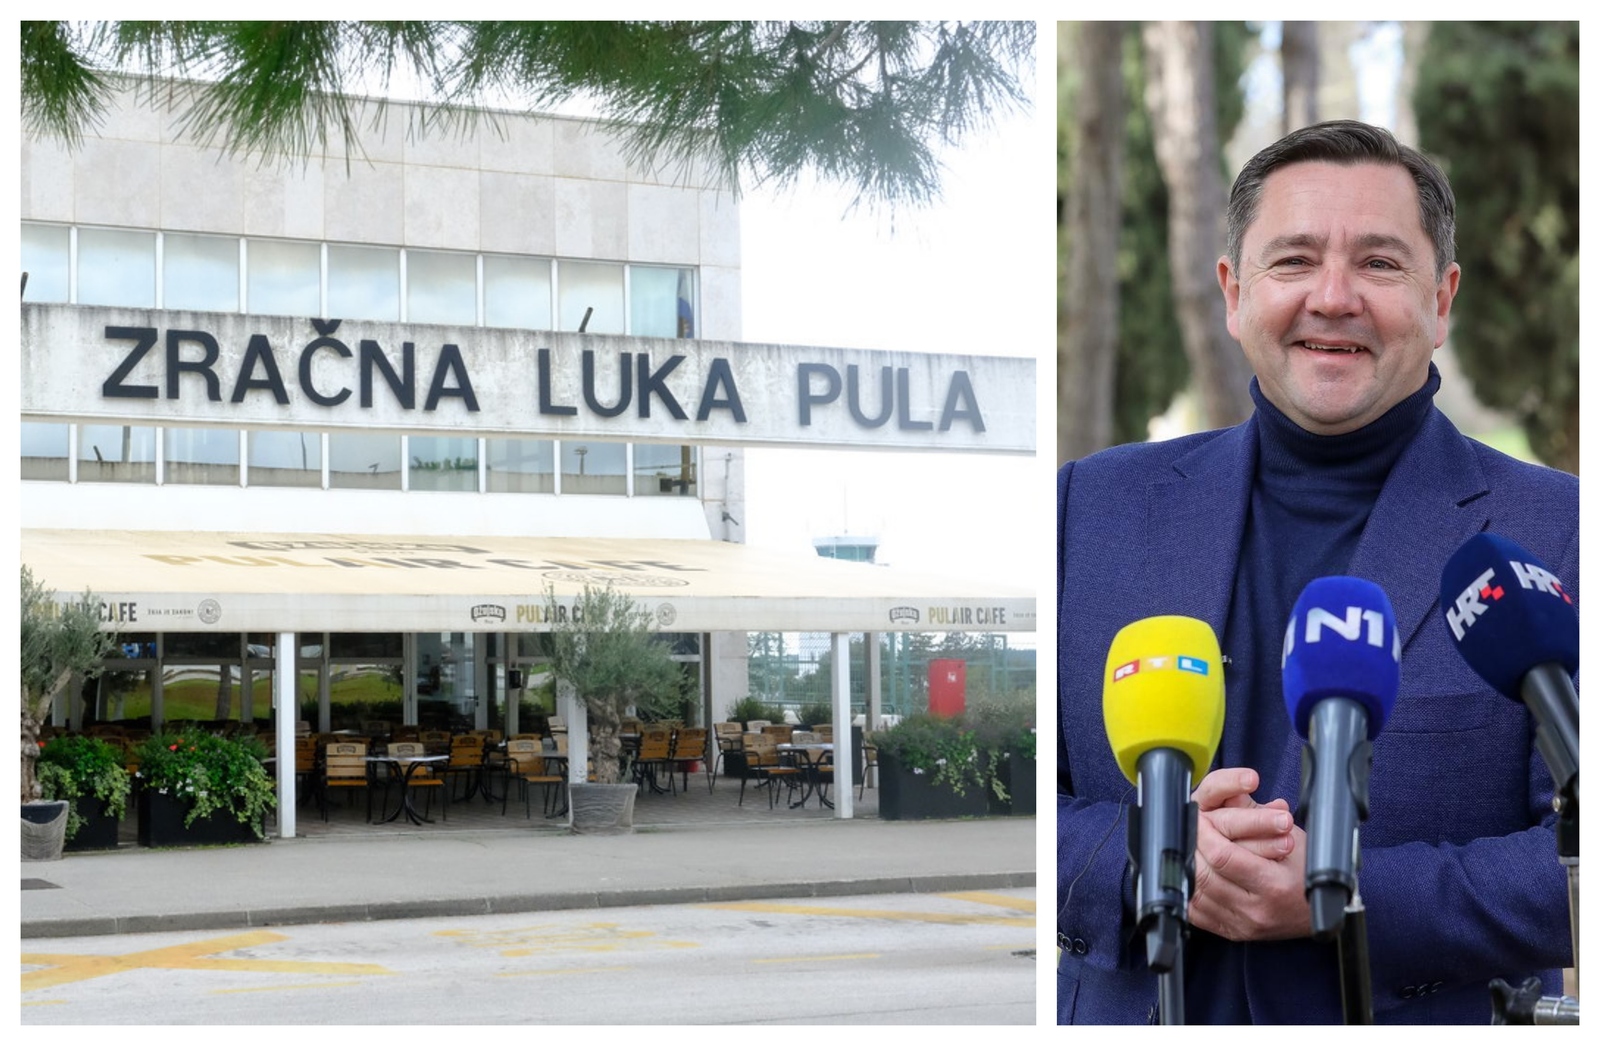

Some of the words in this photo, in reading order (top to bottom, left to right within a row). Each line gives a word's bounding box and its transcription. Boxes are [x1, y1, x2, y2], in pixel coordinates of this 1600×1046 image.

[102, 318, 481, 412] ZRAČNA
[538, 348, 748, 423] LUKA
[797, 362, 986, 432] PULA
[141, 553, 486, 571] PULAIR
[486, 558, 709, 572] CAFE
[1508, 560, 1562, 598] HRT
[98, 602, 137, 622] CAFE
[516, 604, 568, 624] PULAIR
[928, 606, 973, 625] PULAIR
[976, 606, 1006, 625] CAFE
[1446, 567, 1496, 642] HRT
[1305, 605, 1384, 648] N1
[1113, 656, 1207, 681] RTL
